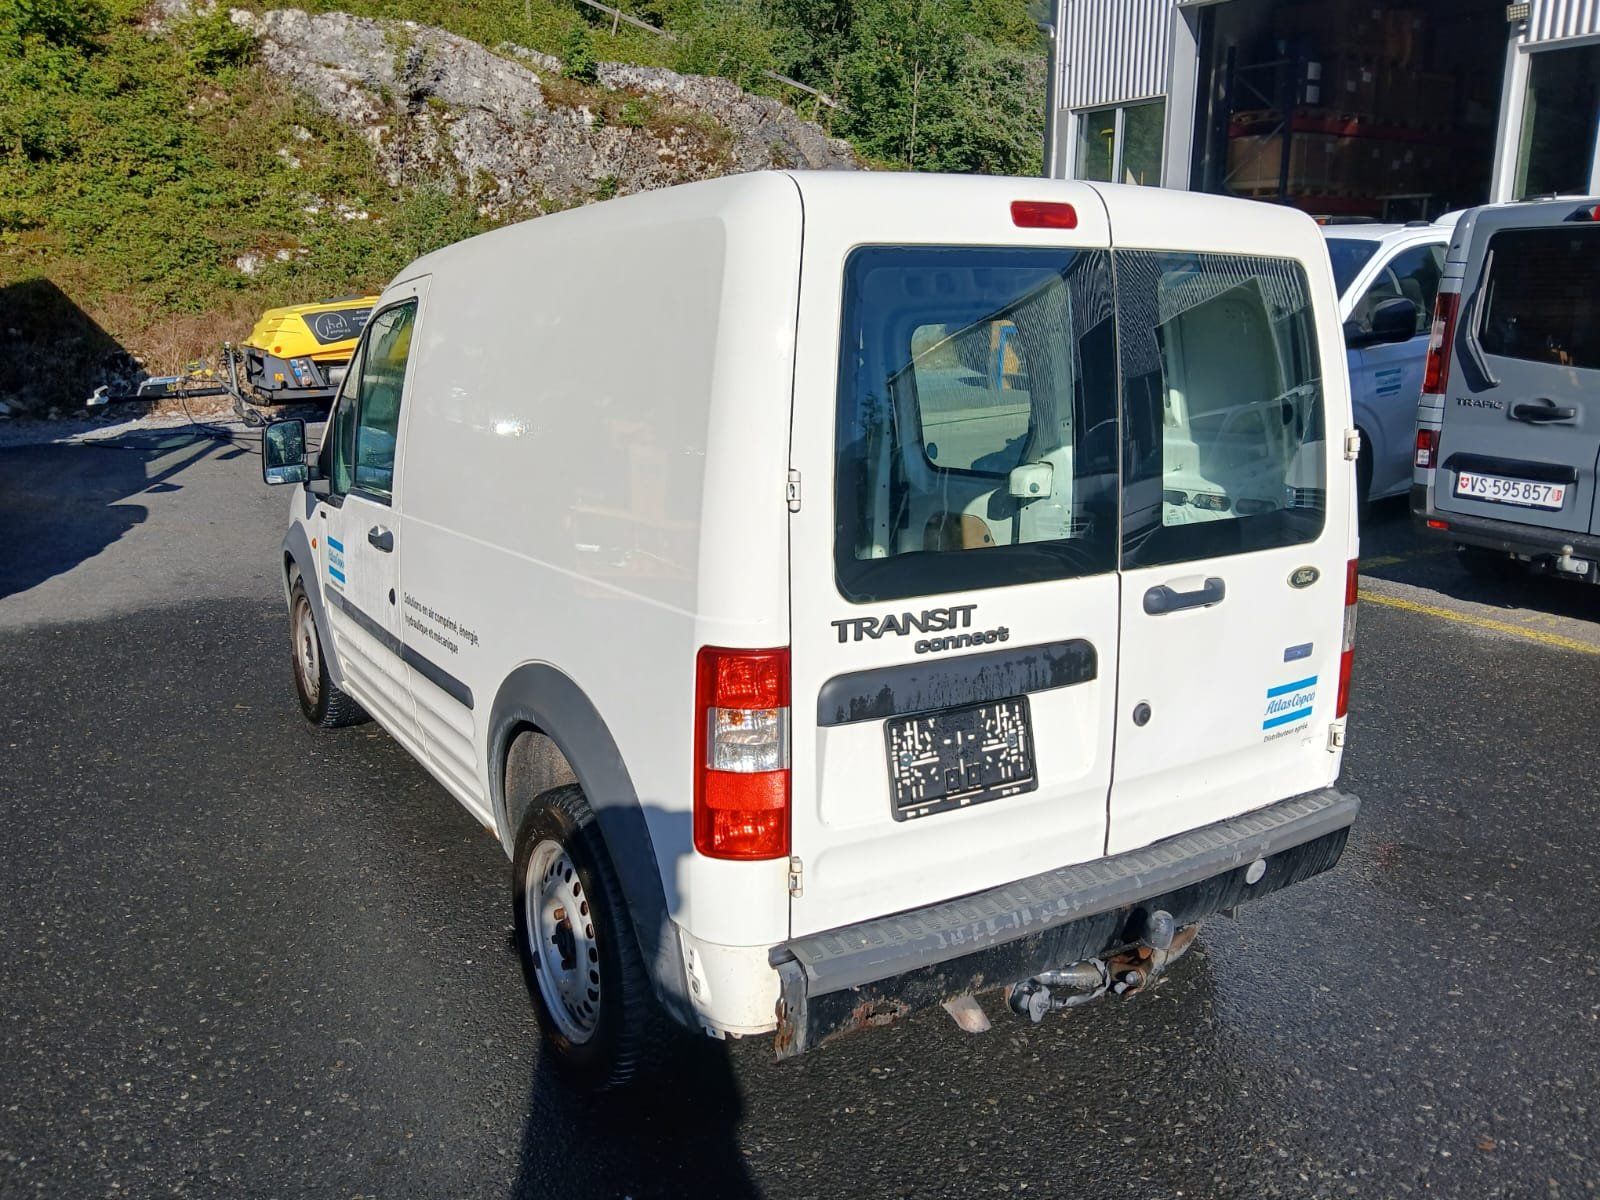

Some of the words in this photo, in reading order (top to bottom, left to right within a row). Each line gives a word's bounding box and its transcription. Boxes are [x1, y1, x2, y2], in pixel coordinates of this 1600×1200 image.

[1456, 398, 1503, 410] TRAFIC
[831, 604, 977, 643] TRANSIT
[915, 626, 1009, 653] connect
